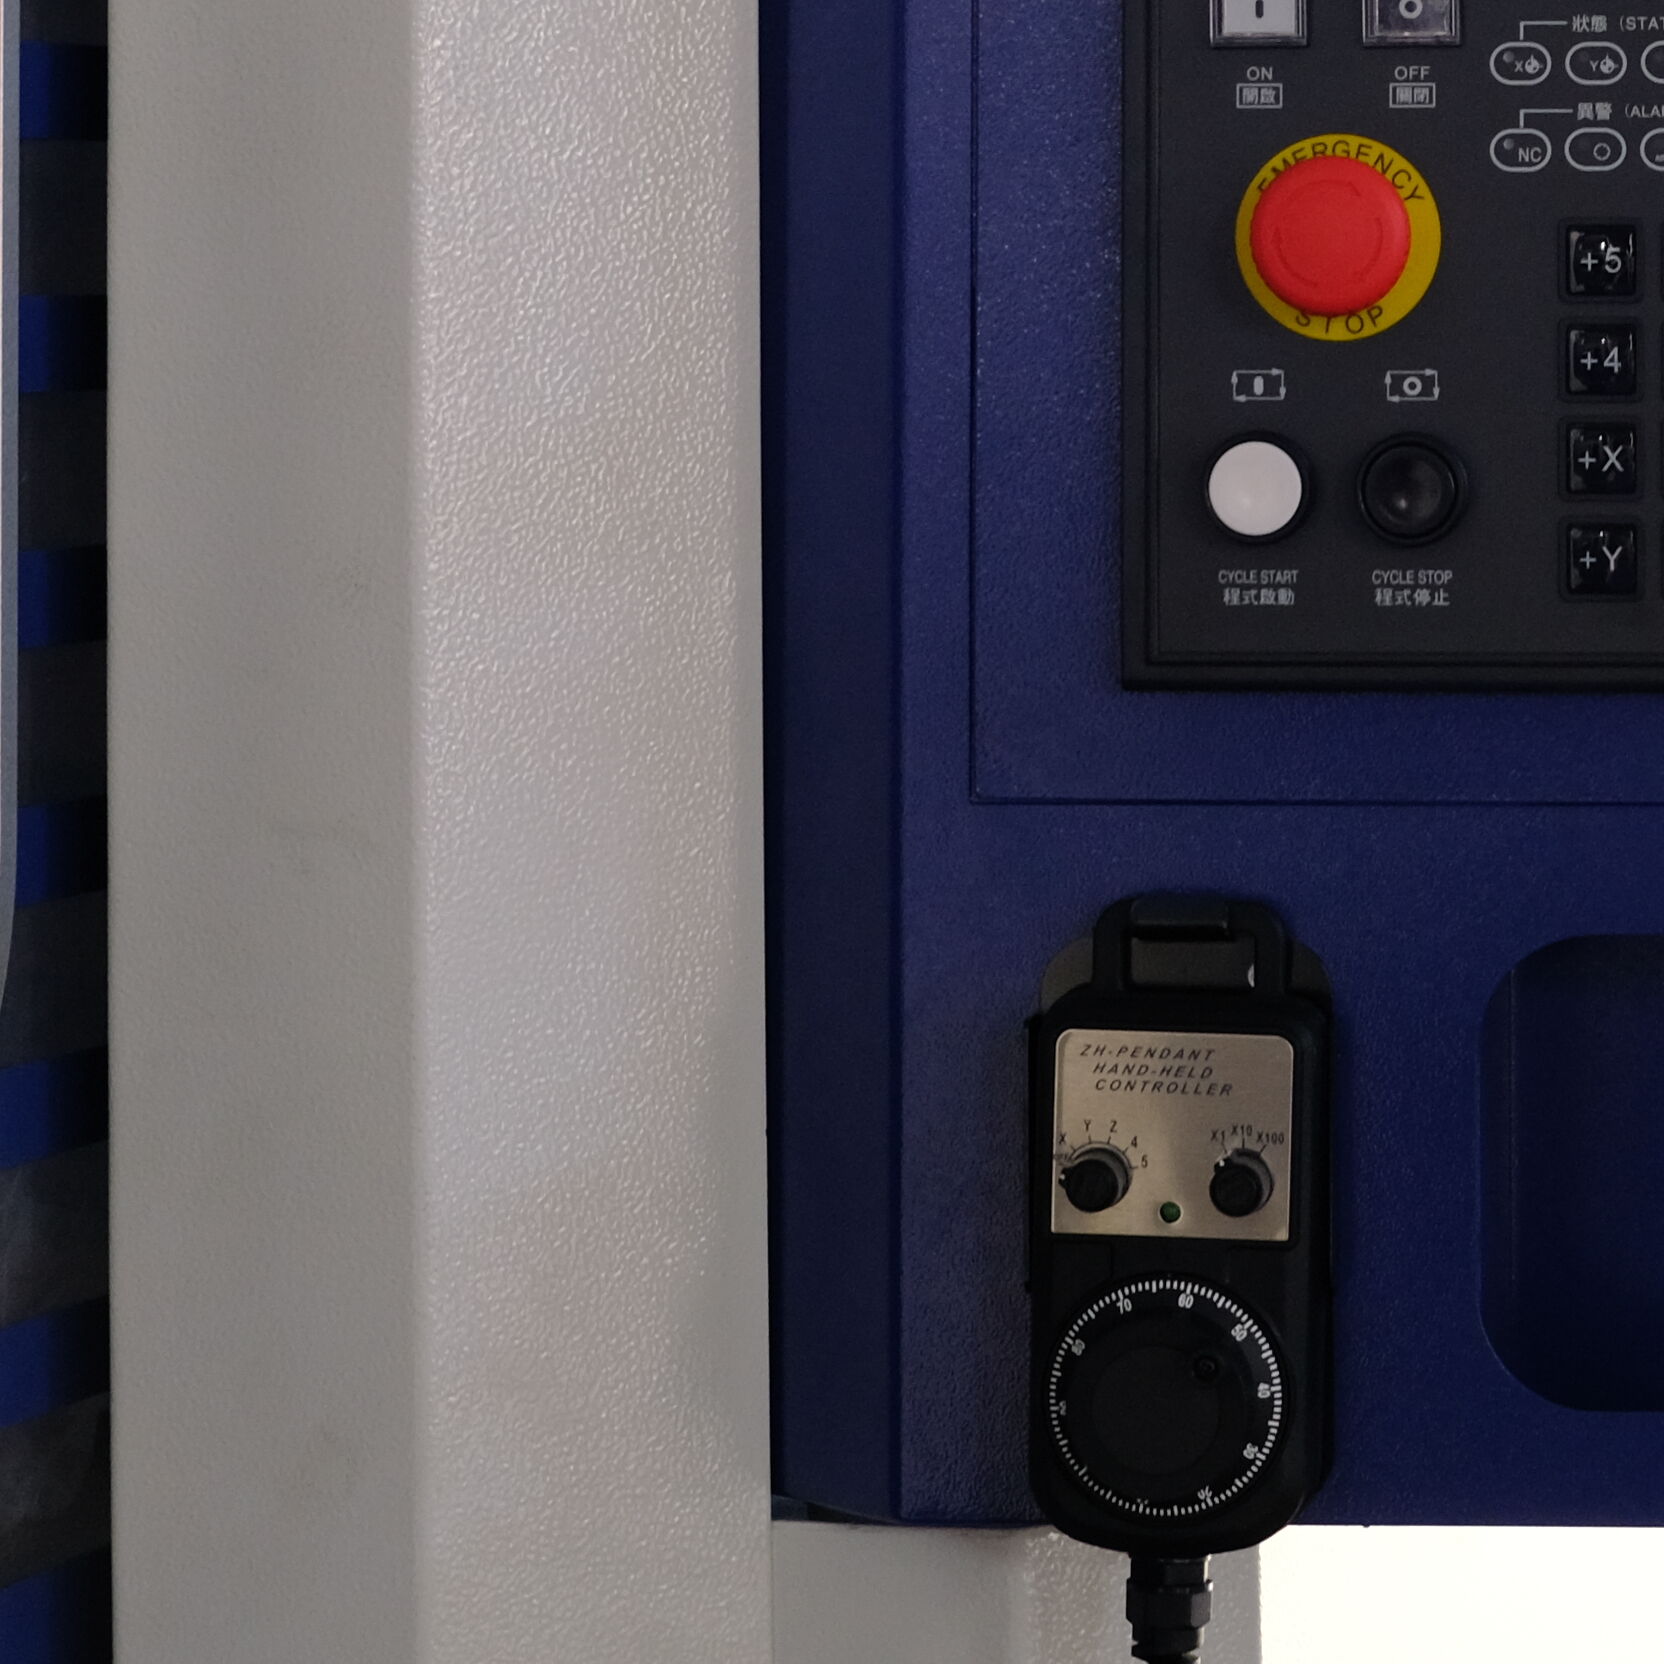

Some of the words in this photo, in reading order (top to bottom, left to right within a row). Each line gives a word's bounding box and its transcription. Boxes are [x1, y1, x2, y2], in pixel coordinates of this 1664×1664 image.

[1246, 65, 1274, 82] ON
[1394, 65, 1431, 81] OFF
[1517, 146, 1542, 163] NC
[1580, 246, 1622, 275] +5
[1295, 305, 1384, 335] STOP
[1580, 346, 1622, 374] +4
[1577, 444, 1625, 473] +X
[1579, 545, 1623, 573] +Y
[1218, 569, 1258, 585] CYCLE
[1259, 568, 1299, 585] START
[1372, 569, 1414, 586] CYCLE
[1416, 568, 1454, 586] STOP
[1093, 1061, 1215, 1080] HAND-HELD
[1095, 1078, 1235, 1098] CONTROLLER
[1230, 1124, 1252, 1138] X10
[1255, 1131, 1284, 1145] X100
